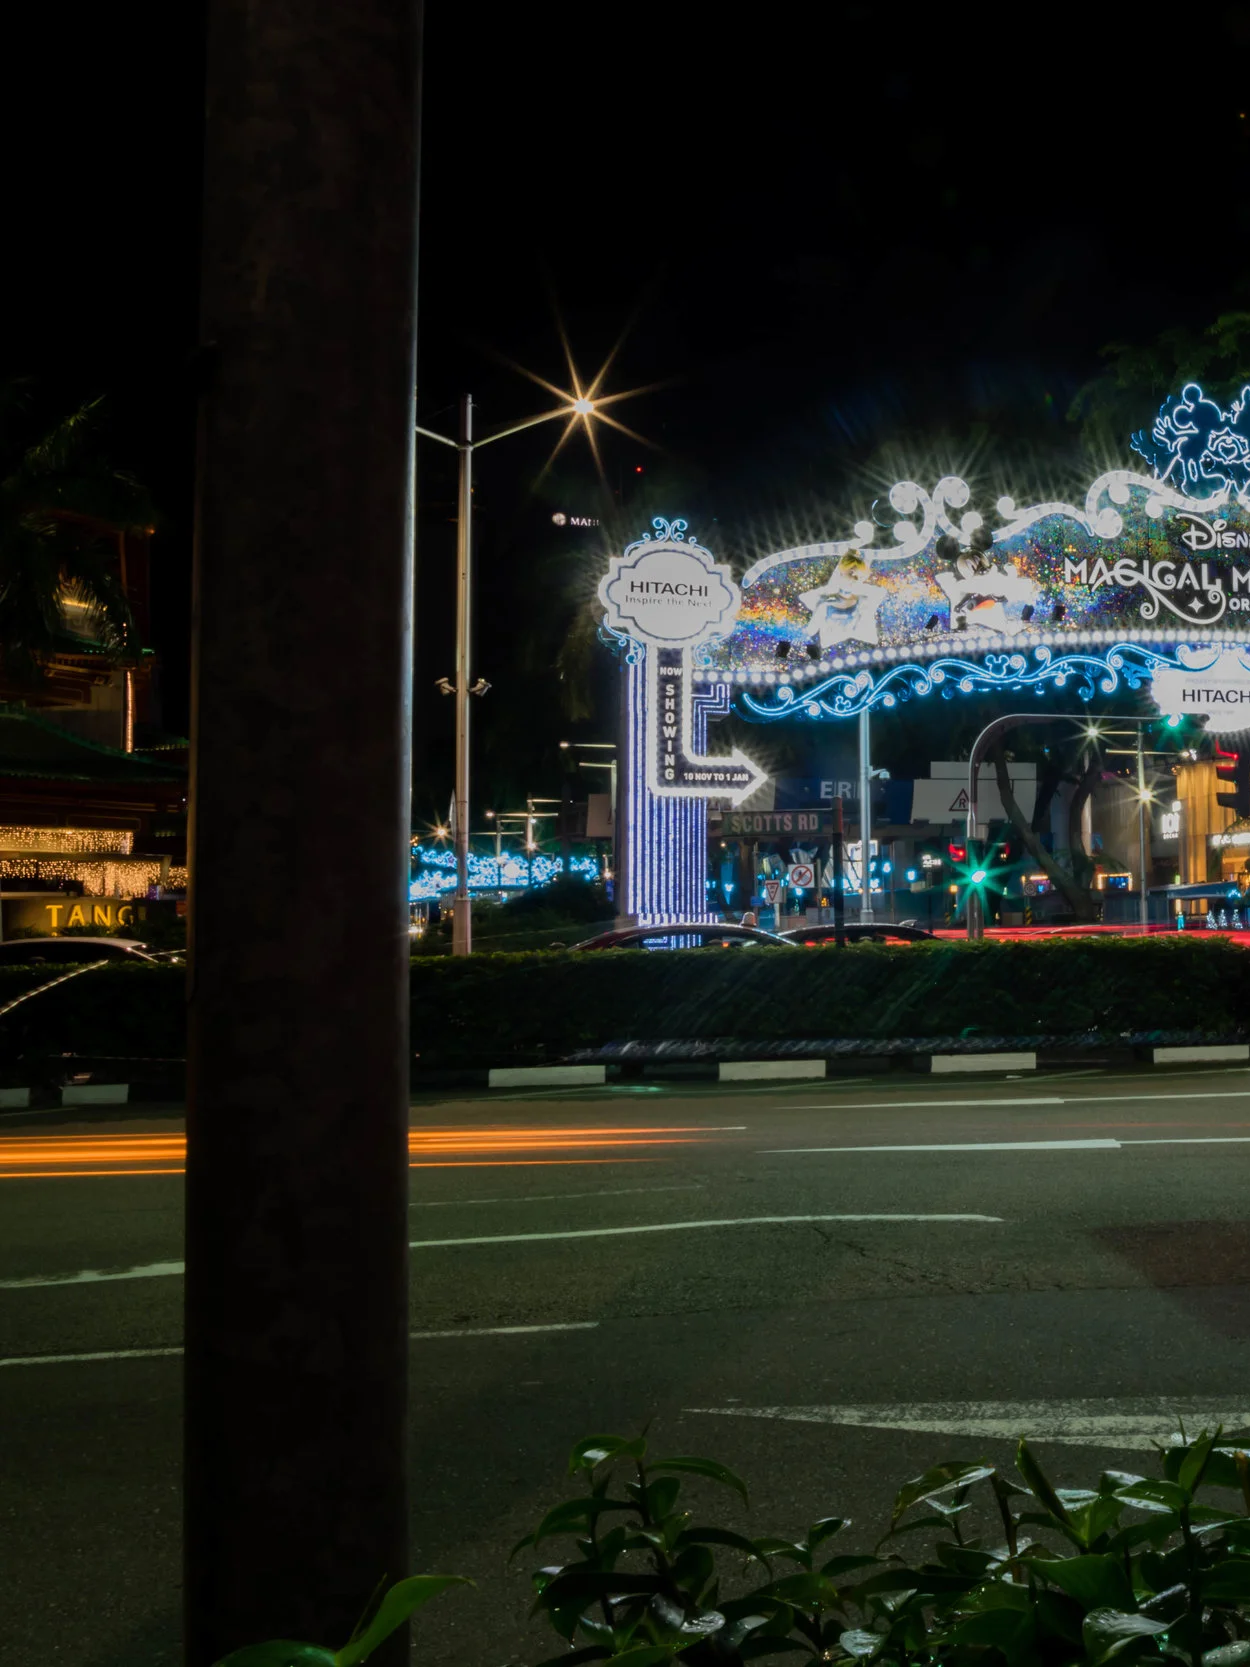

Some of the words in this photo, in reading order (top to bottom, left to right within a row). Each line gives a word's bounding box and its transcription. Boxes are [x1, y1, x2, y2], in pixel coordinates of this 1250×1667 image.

[630, 580, 708, 598] HITACHI
[1064, 556, 1227, 624] MAGICAL
[625, 594, 664, 606] Inspire
[660, 666, 683, 677] NOW
[662, 684, 677, 781] SHOWING
[683, 772, 694, 781] 10
[695, 772, 712, 781] NOV
[713, 773, 725, 781] TO
[726, 773, 731, 781] 1
[732, 773, 749, 782] JAN
[820, 780, 862, 799] ER
[731, 814, 793, 833] SCOTTS
[799, 813, 819, 831] RD
[45, 904, 147, 930] TANG
